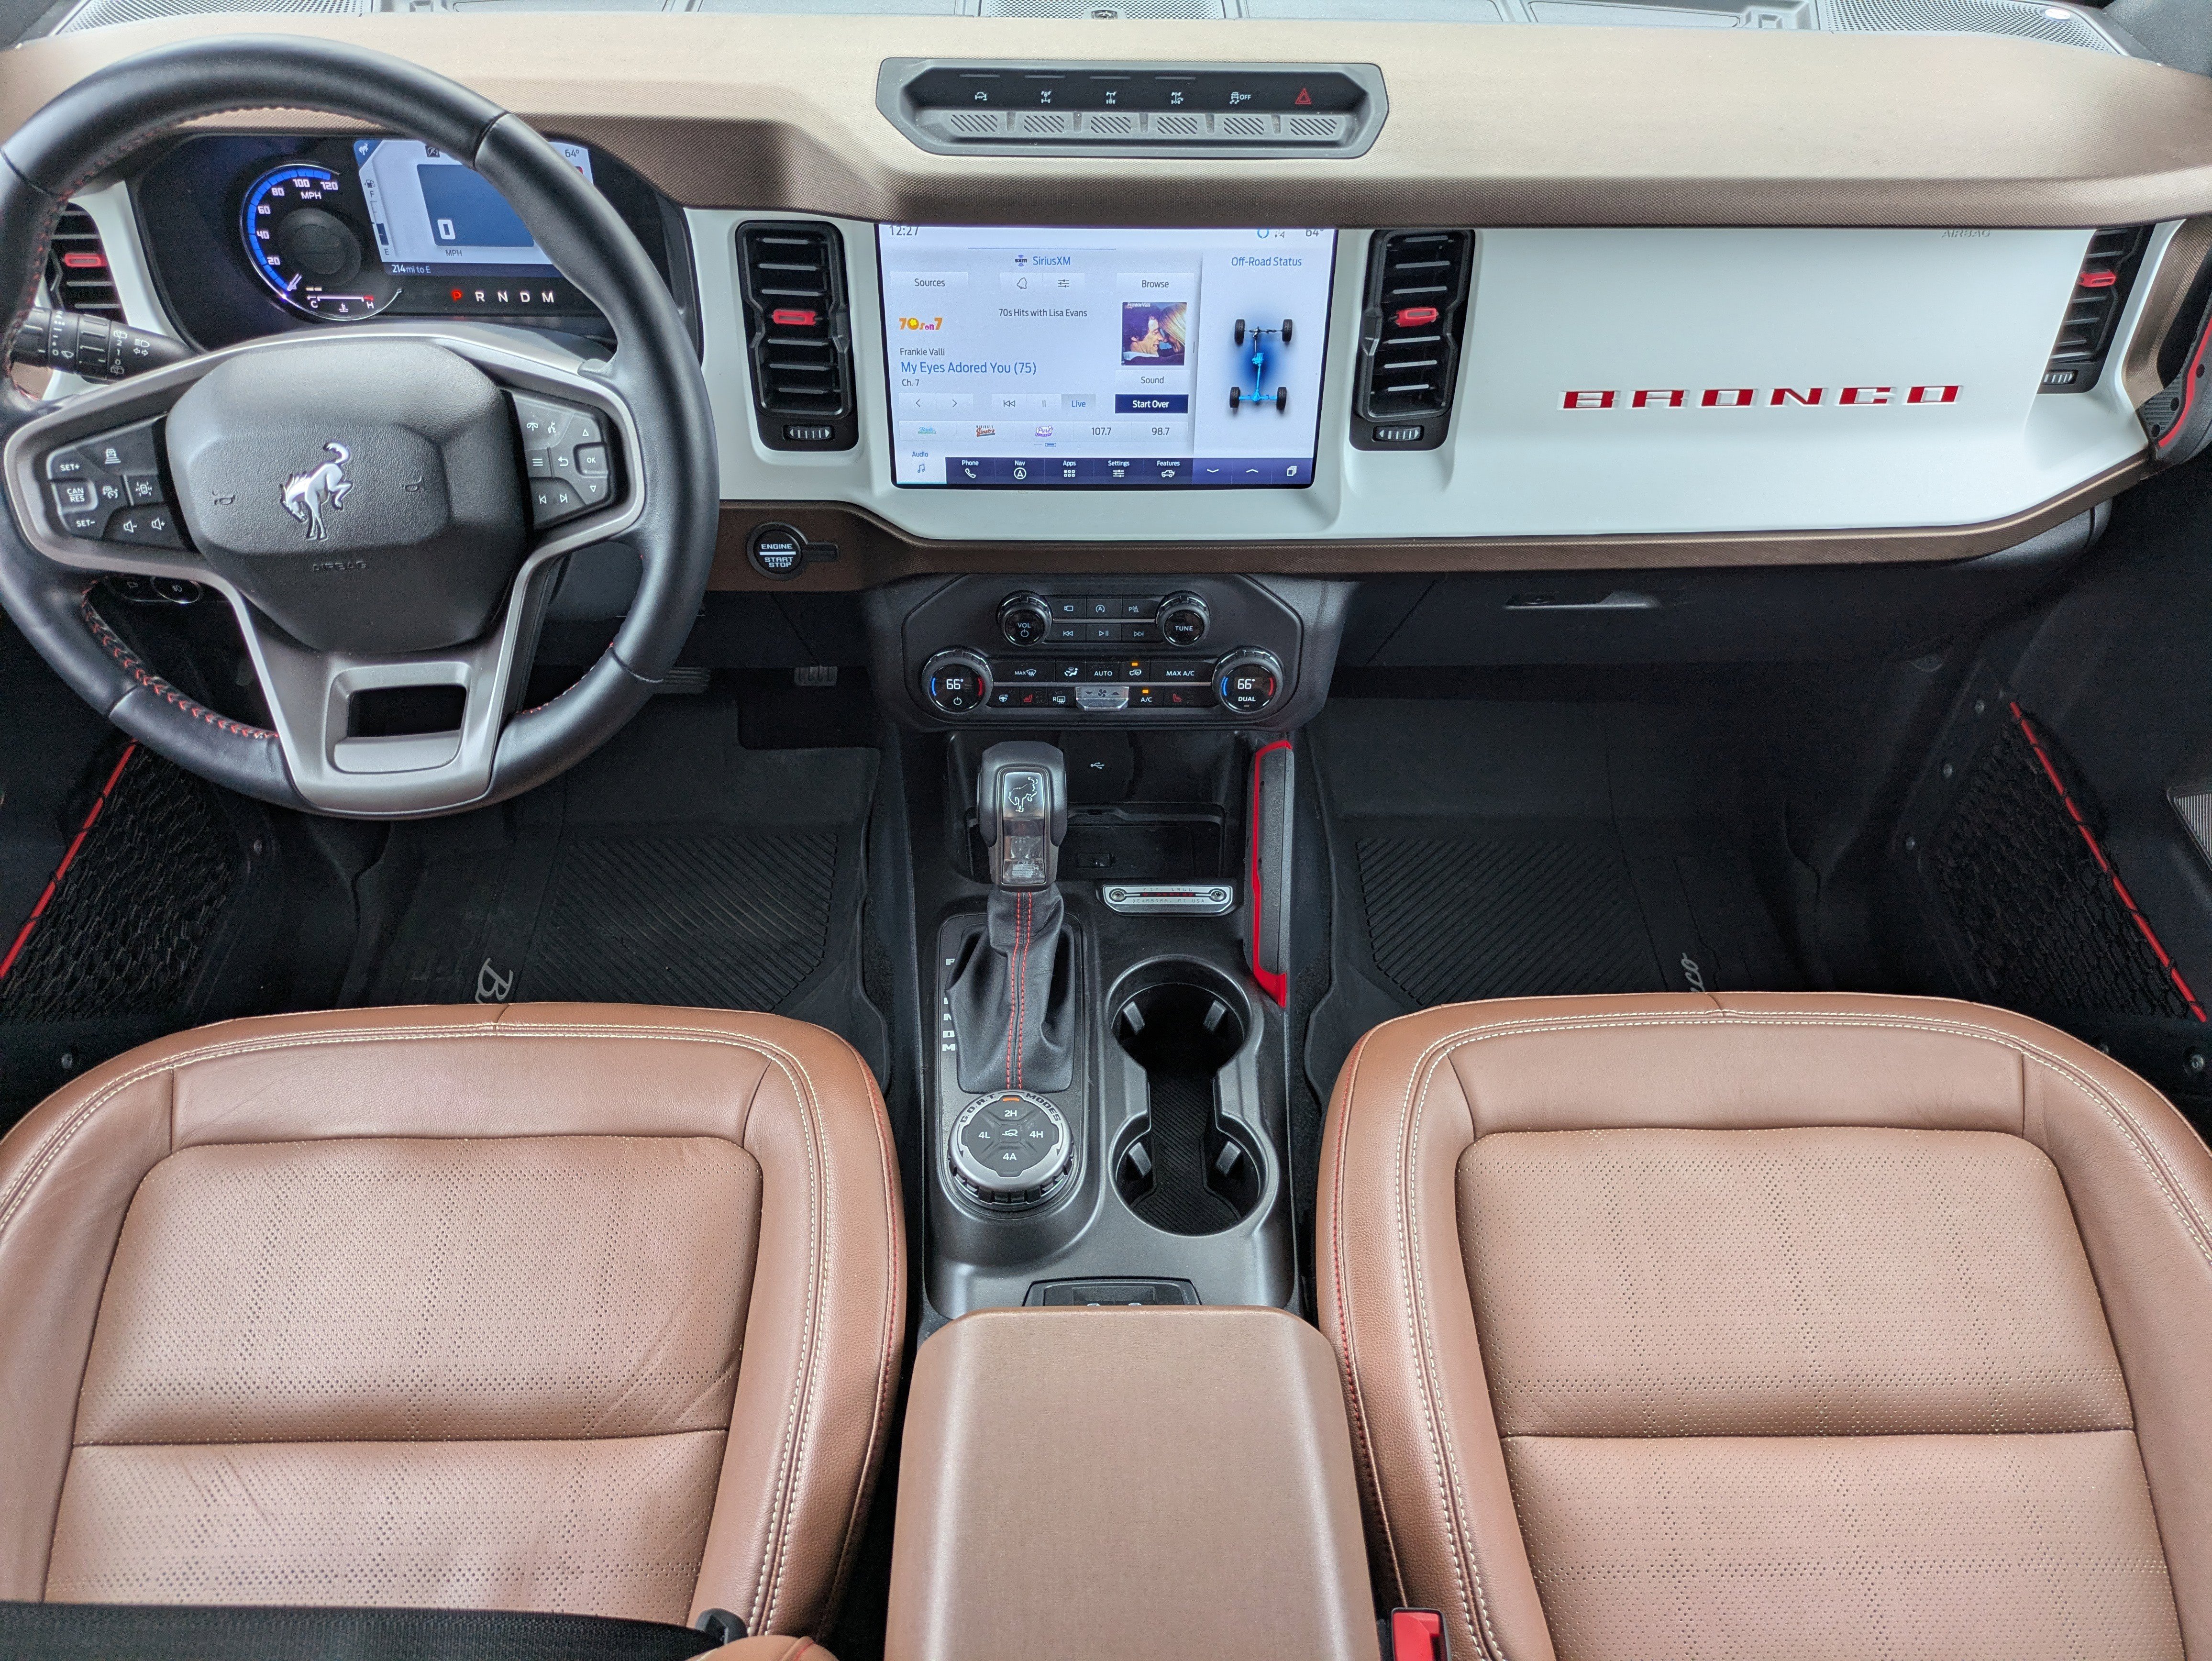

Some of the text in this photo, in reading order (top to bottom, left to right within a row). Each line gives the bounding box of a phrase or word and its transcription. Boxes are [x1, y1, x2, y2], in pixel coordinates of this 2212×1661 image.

[293, 179, 310, 188] 100
[321, 181, 339, 190] 120
[271, 187, 285, 196] 80
[257, 205, 271, 214] 60
[437, 219, 455, 240] 0
[889, 226, 919, 236] 12:27
[1941, 230, 1991, 238] AIRBAG
[256, 231, 270, 240] 40
[267, 256, 280, 266] 20
[1032, 256, 1071, 266] SiriusXM
[1231, 257, 1302, 266] Off-Road Status
[914, 278, 946, 287] Sources
[1141, 280, 1169, 288] Browse
[453, 291, 554, 303] P R N D M
[310, 299, 319, 309] C
[365, 300, 374, 309] H
[998, 309, 1087, 317] 70s Hits with Lisa Evans
[900, 348, 945, 356] Frankie Valli
[901, 362, 1037, 375] My Eyes Adored You (75)
[1560, 385, 1960, 410] BRONCO
[1071, 400, 1086, 408] Live
[1132, 400, 1169, 409] Start Over
[1092, 427, 1112, 436] 107.7
[1151, 427, 1170, 436] 98.7
[60, 463, 80, 472] SET+
[66, 487, 84, 495] CAN
[1025, 1092, 1062, 1122] MODES
[1003, 1152, 1017, 1161] 4A
